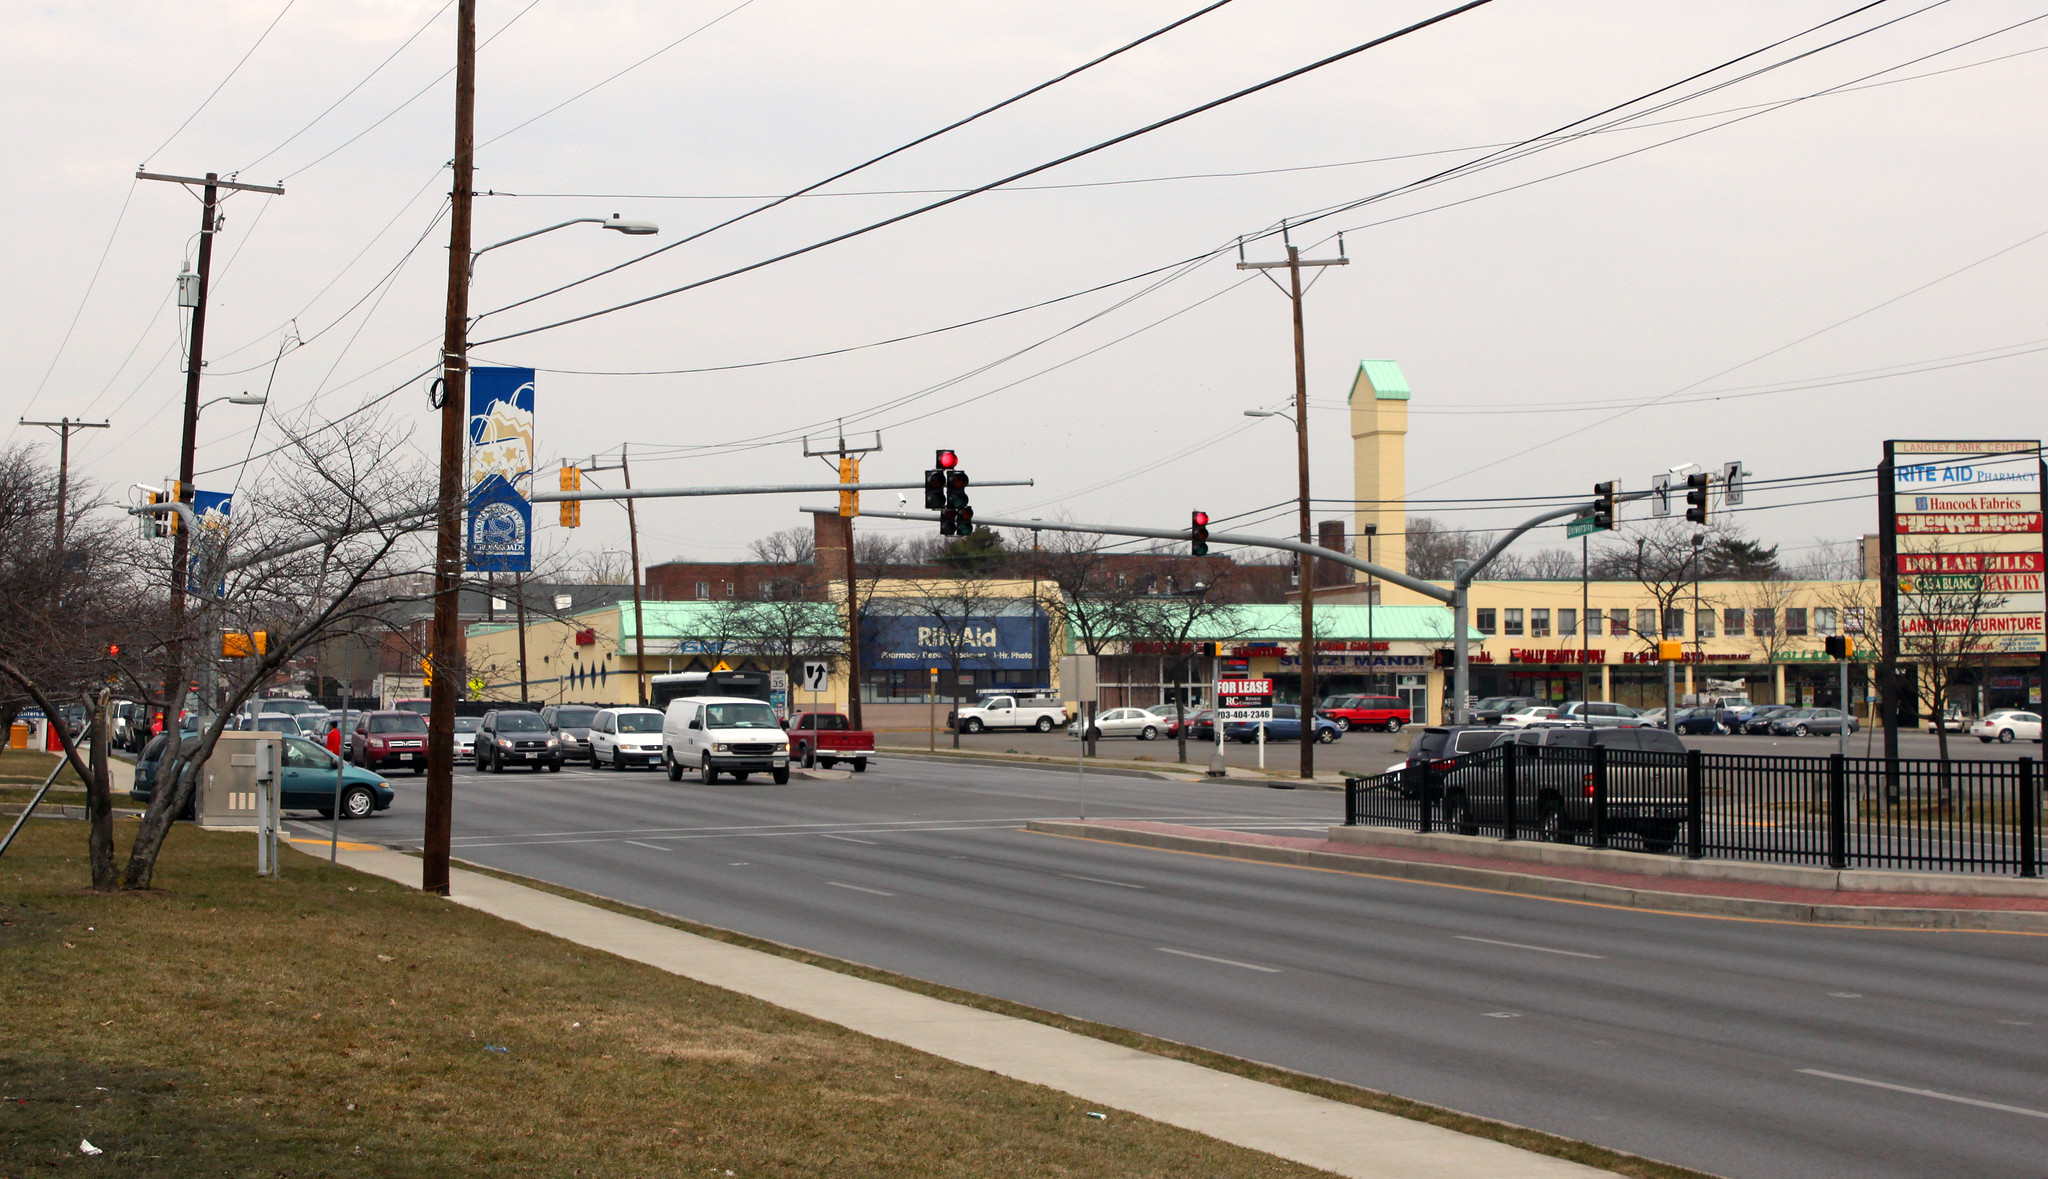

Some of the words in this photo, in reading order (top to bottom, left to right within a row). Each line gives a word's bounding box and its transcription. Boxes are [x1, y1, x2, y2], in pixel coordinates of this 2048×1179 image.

[1903, 443, 1950, 452] LANGLEY
[1955, 443, 1982, 452] PARK
[1987, 442, 2029, 452] CENTER
[1898, 466, 1937, 482] RITE
[1942, 465, 1974, 482] AID
[1930, 497, 1978, 511] Hancock
[1980, 497, 2021, 510] Fabrics
[1905, 557, 1978, 571] DOLLAR
[1984, 555, 2035, 570] BILLS
[1983, 574, 2041, 591] BAKERY
[1902, 618, 1970, 633] LANDMARK
[1973, 617, 2042, 632] FURNITURE
[918, 627, 959, 647] Rite
[961, 626, 997, 647] Aid
[680, 641, 734, 653] GNC
[1233, 647, 1288, 658] FURNITURE
[1011, 651, 1033, 659] Photo
[1280, 656, 1346, 667] SUZI
[1354, 656, 1425, 666] MANDI
[1521, 649, 1545, 663] SALLY
[1546, 649, 1576, 663] BEAUTY
[773, 680, 784, 688] 35
[1217, 682, 1237, 694] FOR
[1239, 681, 1269, 693] LEASE
[1226, 697, 1240, 706] RC
